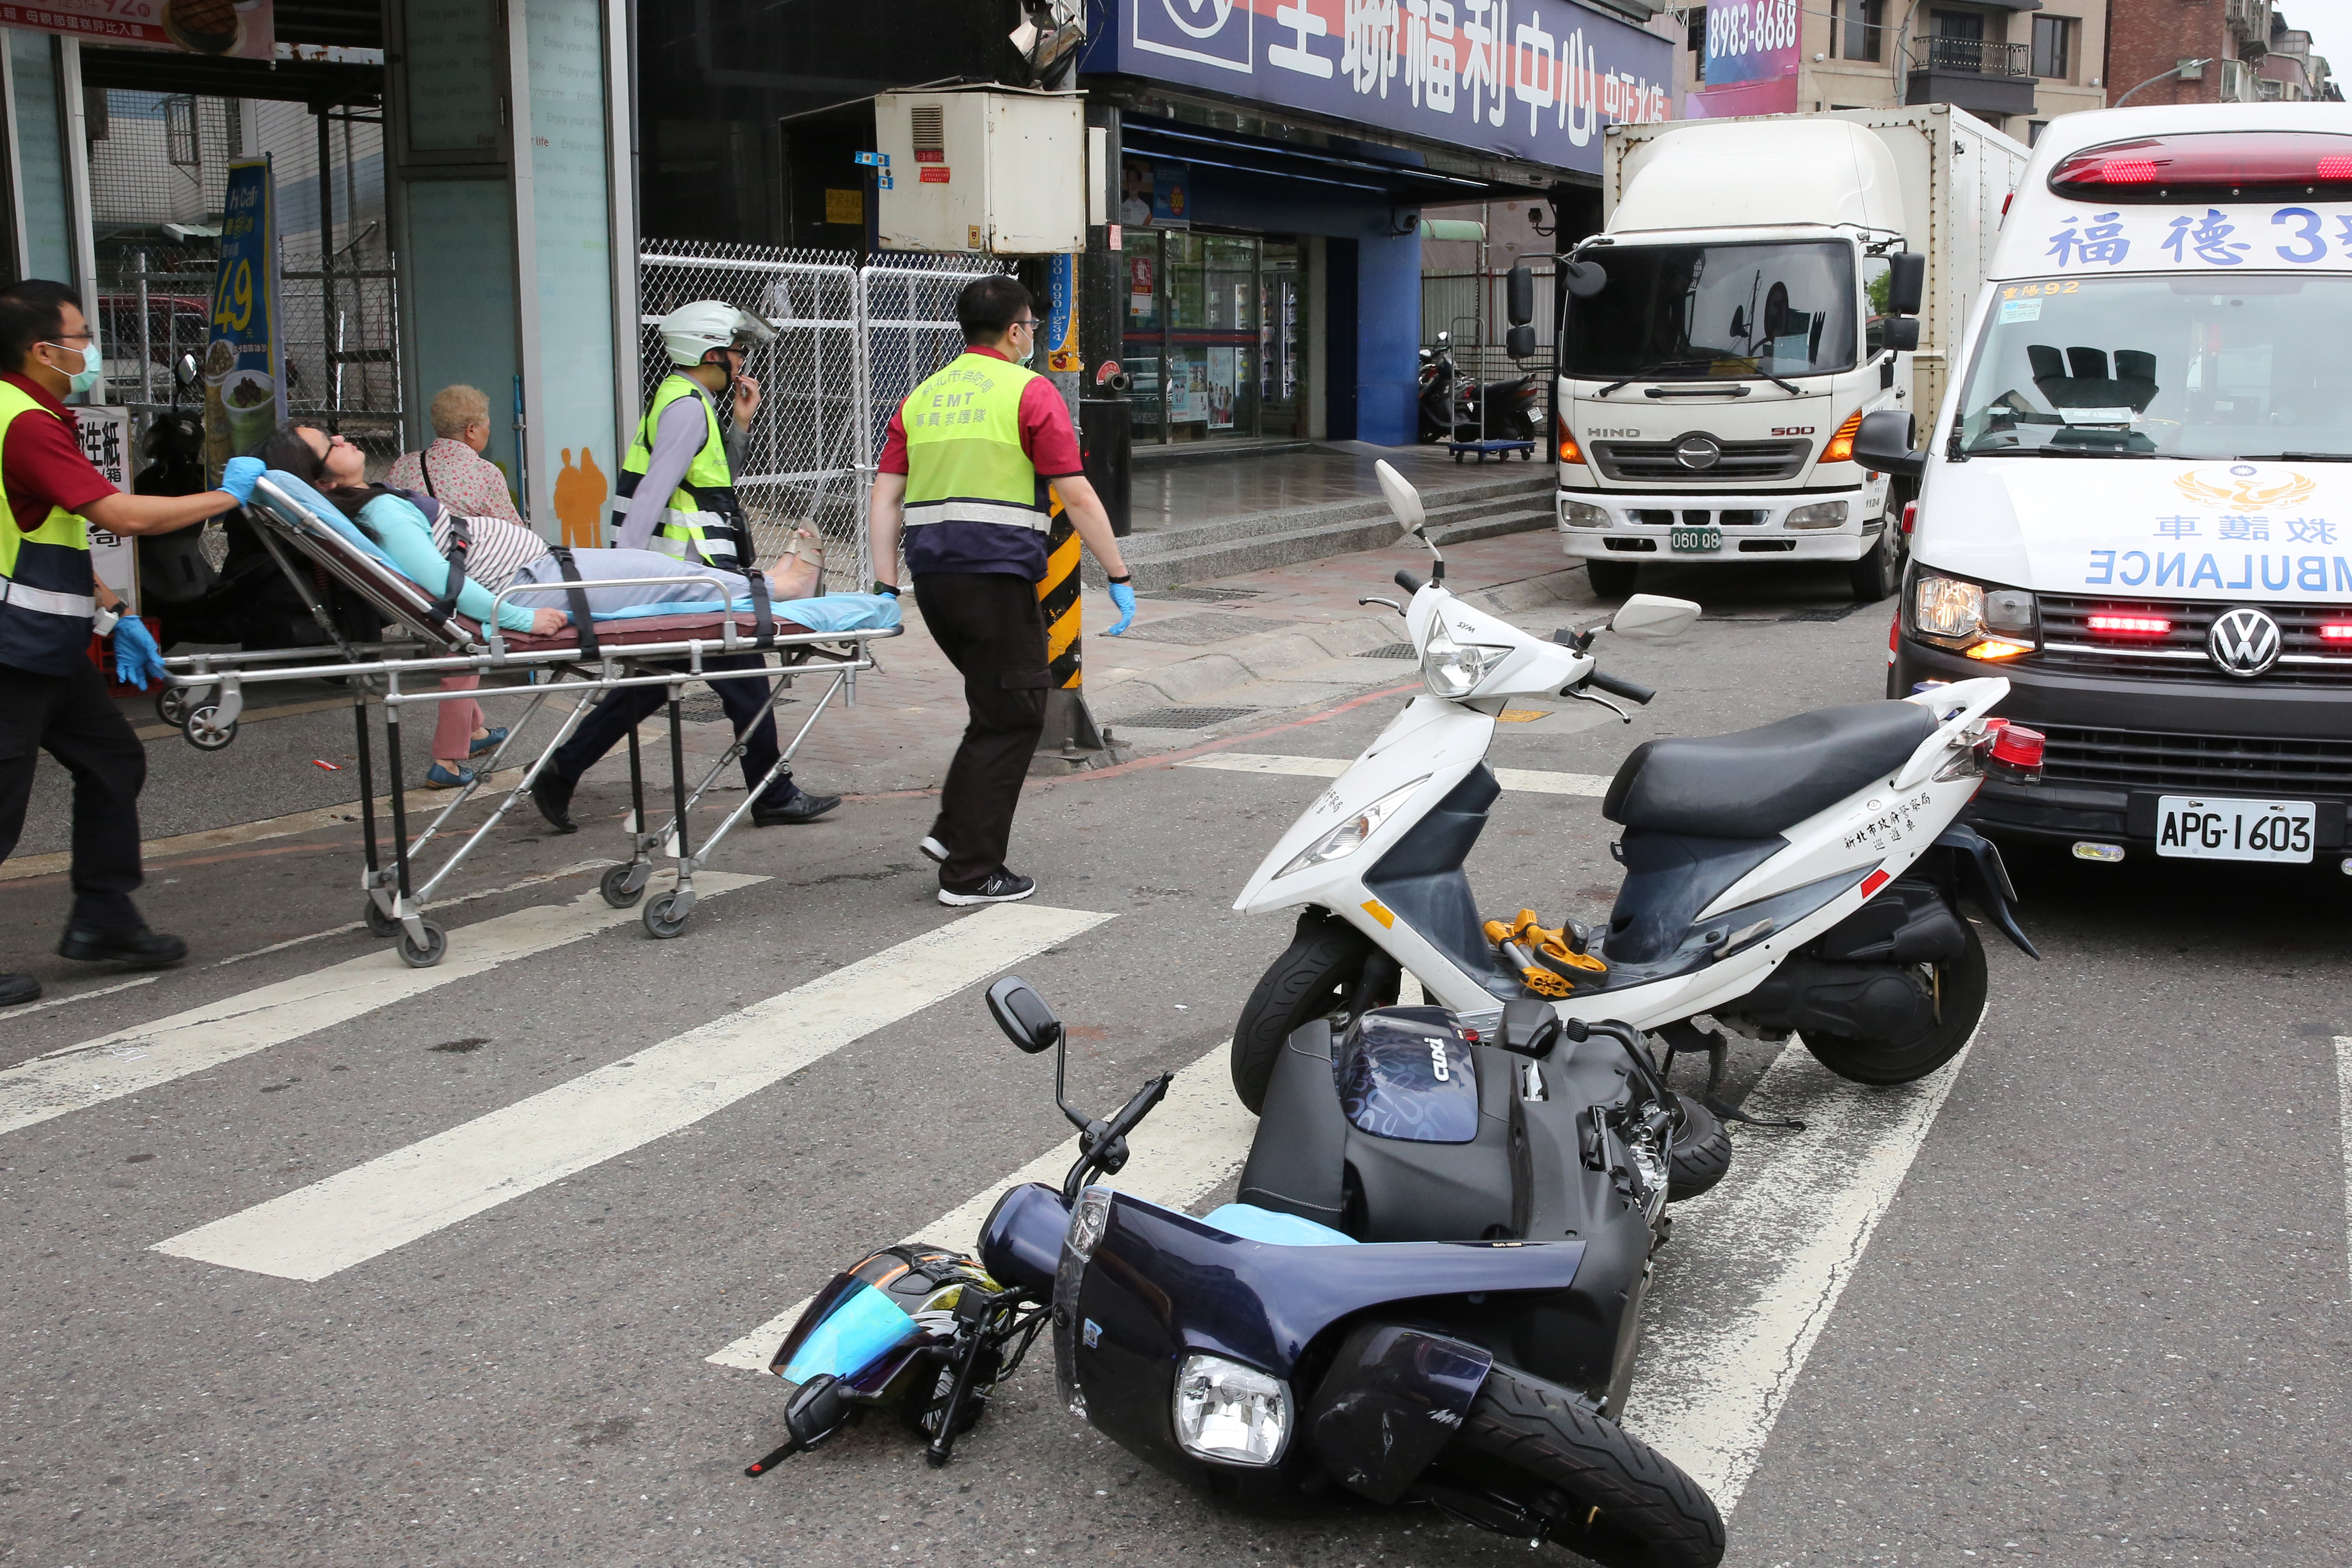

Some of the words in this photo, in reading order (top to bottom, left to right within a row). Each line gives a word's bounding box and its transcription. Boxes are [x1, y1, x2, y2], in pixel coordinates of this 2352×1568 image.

[548, 13, 561, 24] life
[1710, 0, 1796, 59] 8983-8688
[543, 36, 564, 50] Enjoy
[566, 41, 583, 52] your
[473, 58, 492, 68] Enjo
[558, 64, 579, 77] Enjoy
[552, 90, 564, 99] life
[547, 112, 568, 126] Enjoy
[569, 116, 586, 127] your
[477, 134, 495, 145] Enjo
[536, 136, 549, 147] life
[561, 139, 583, 151] Enjoy
[555, 163, 567, 173] life
[550, 188, 571, 200] Enjoy
[572, 191, 589, 200] your
[1171, 194, 1184, 207] 300
[564, 214, 585, 226] Enjoy
[2045, 208, 2352, 266] 福德3
[214, 258, 252, 333] 49
[922, 369, 994, 396] 新北市消防局
[932, 392, 974, 407] EMT
[916, 408, 986, 427] 專責救護隊
[1588, 427, 1640, 437] HINO
[1771, 426, 1815, 436] 500
[1865, 497, 1880, 508] 1124
[1457, 621, 1475, 633] SYM
[1843, 792, 1931, 850] 新北市政府警察局
